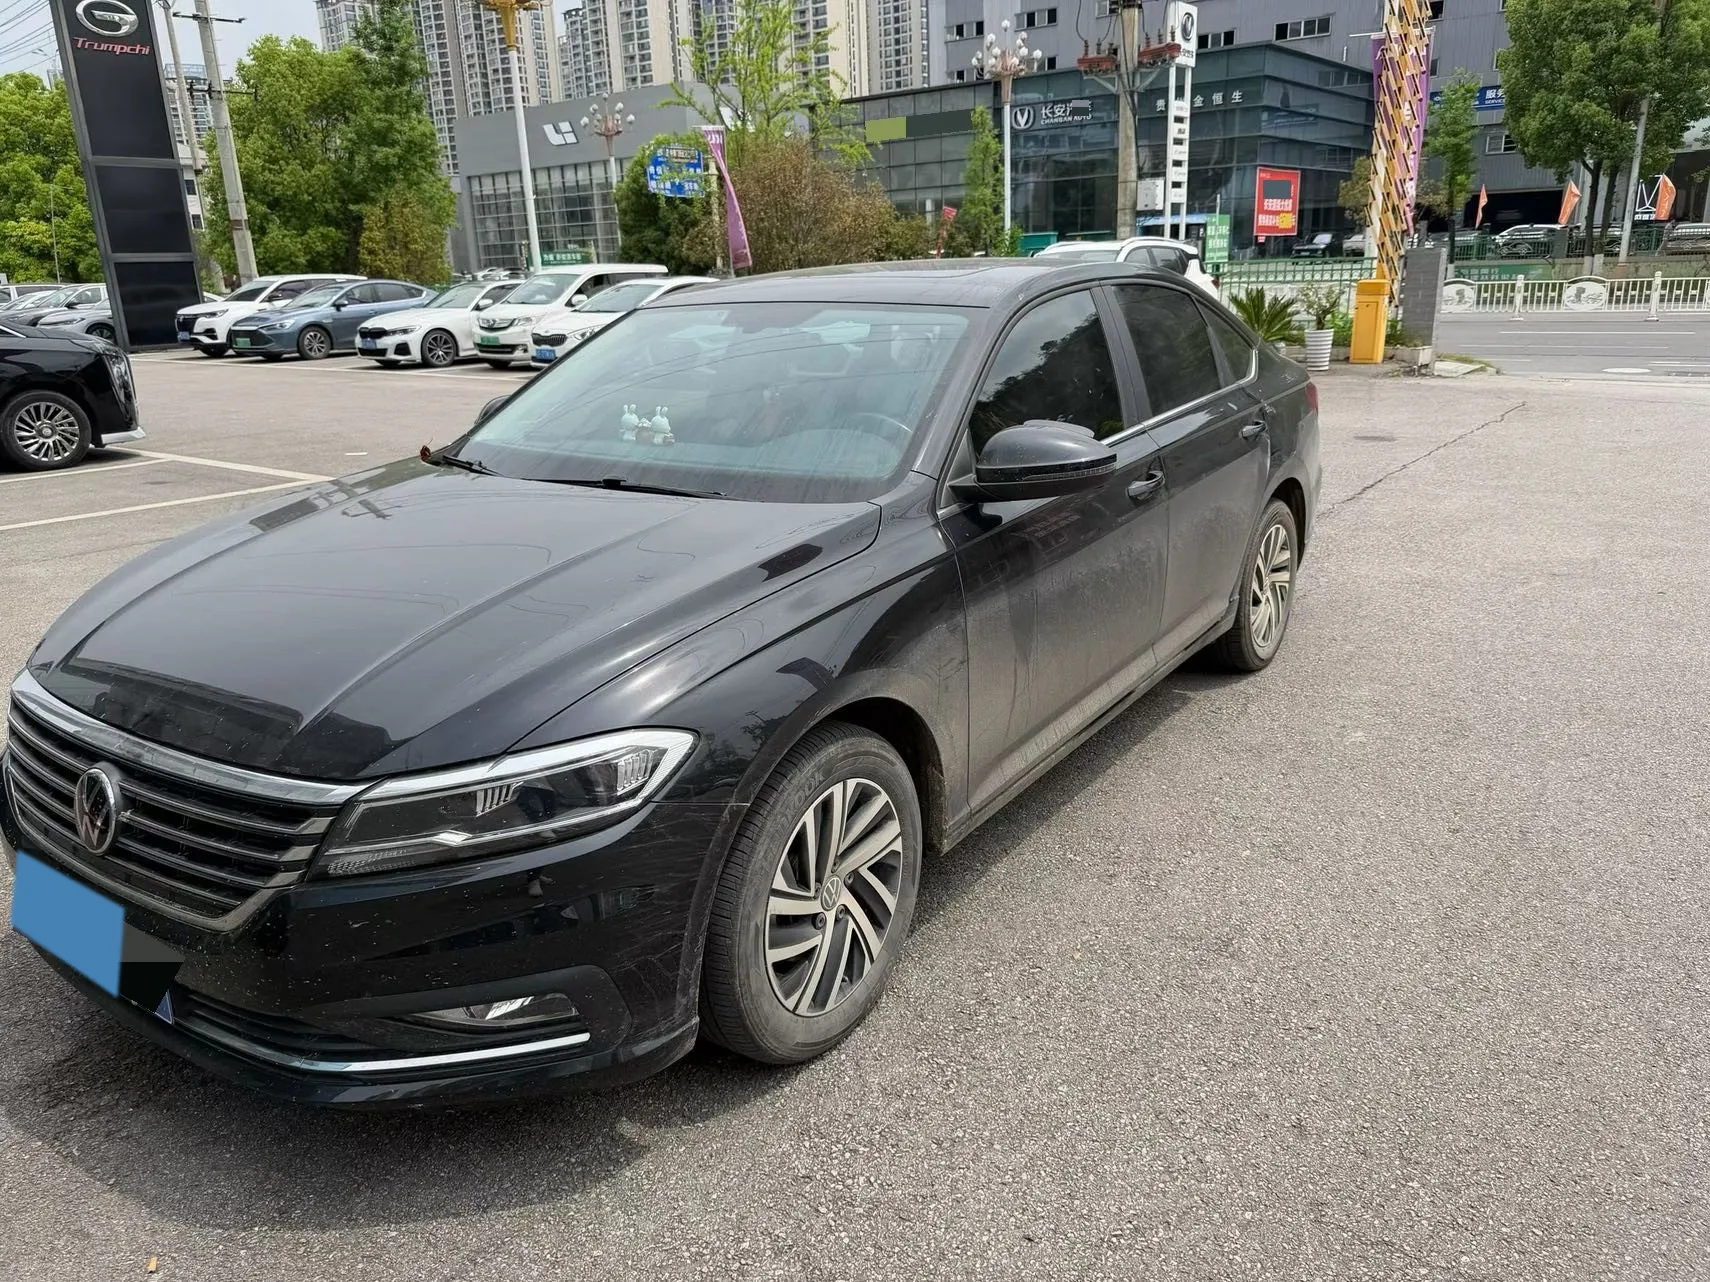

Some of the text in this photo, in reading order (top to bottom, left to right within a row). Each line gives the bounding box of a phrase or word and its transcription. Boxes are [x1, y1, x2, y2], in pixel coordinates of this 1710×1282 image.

[73, 37, 150, 55] Trumpchi
[1156, 90, 1243, 112] 贵金恒生
[1041, 116, 1072, 125] CHANGAN
